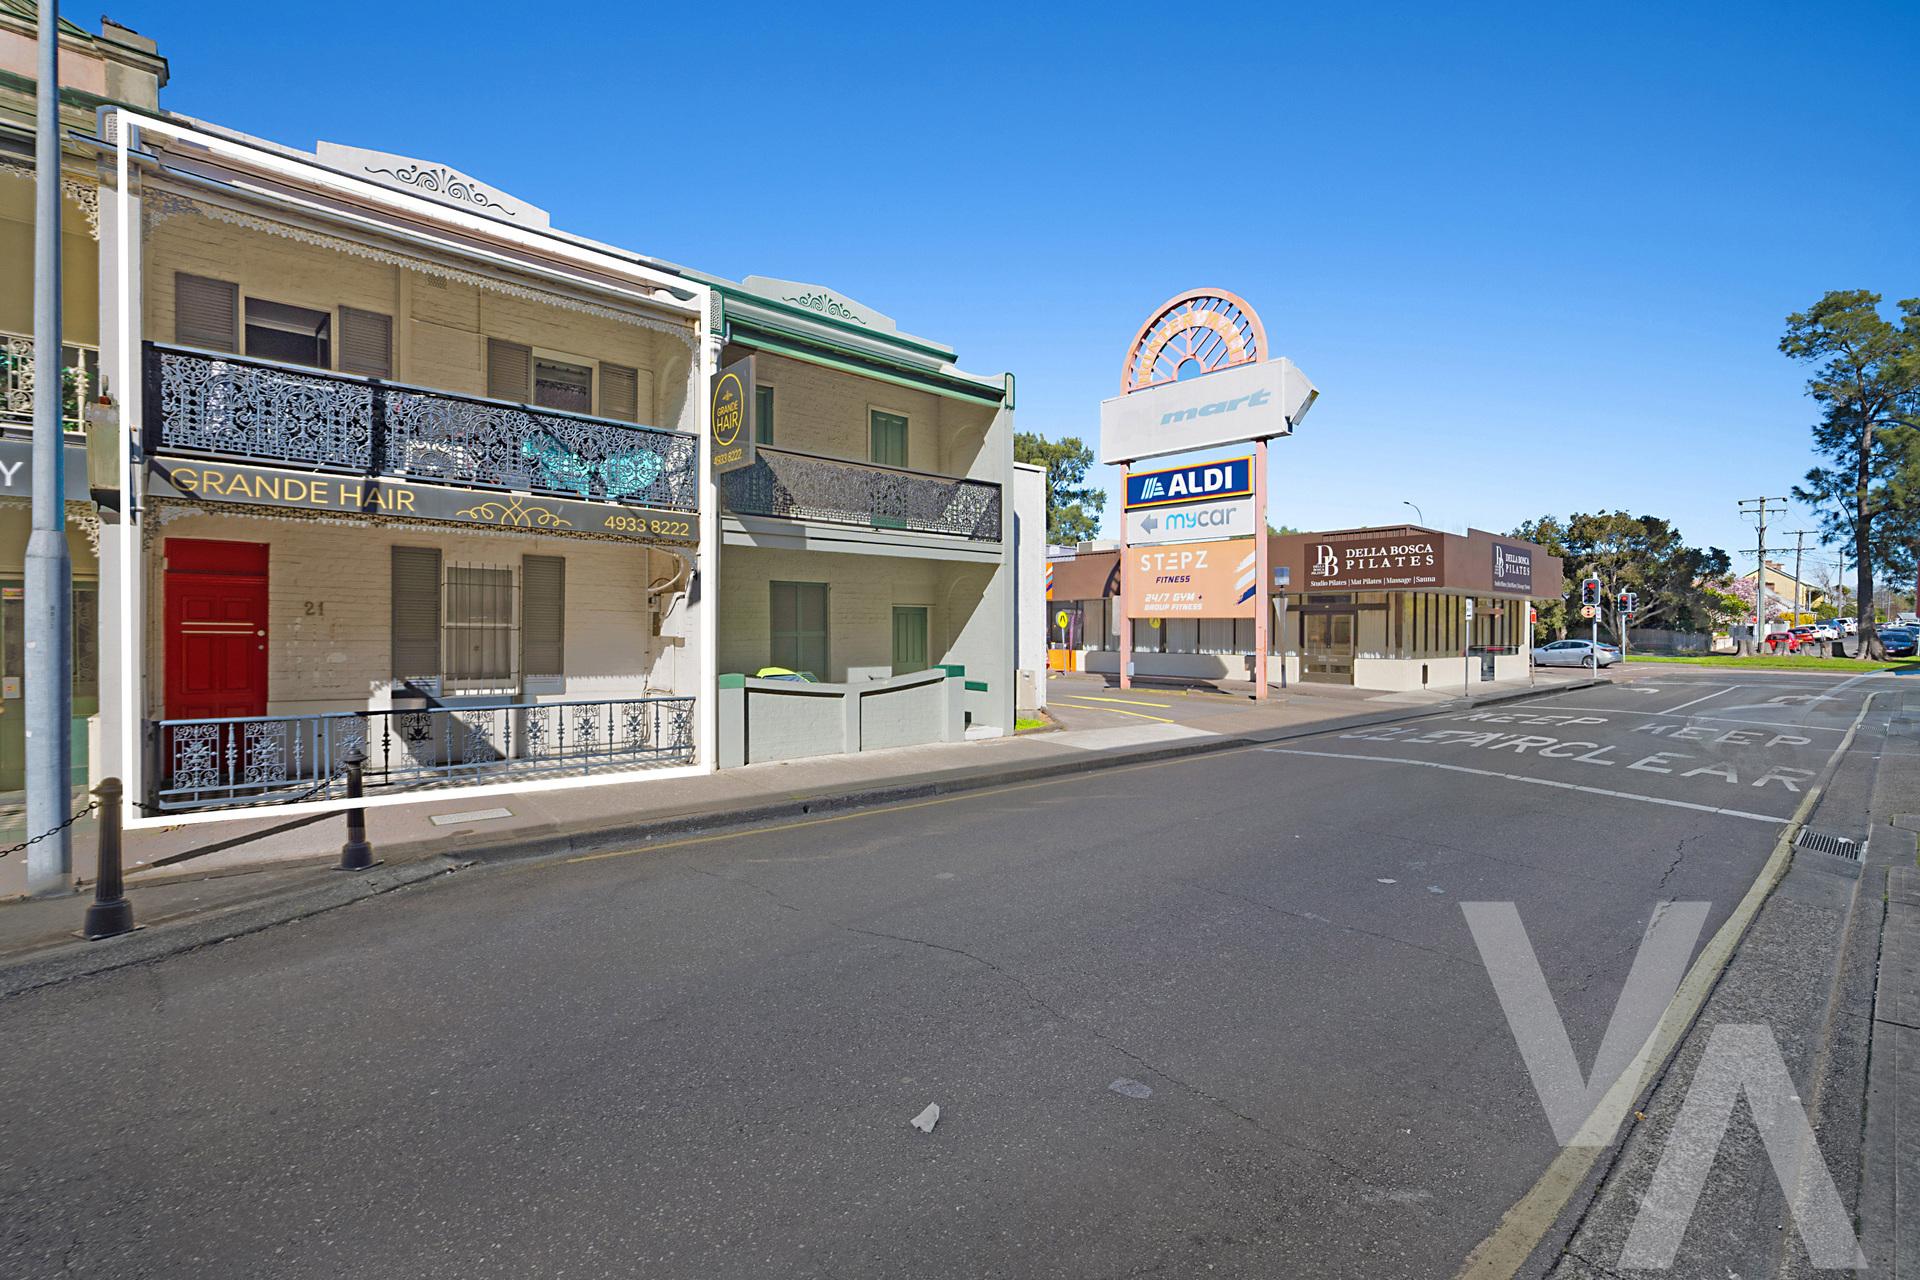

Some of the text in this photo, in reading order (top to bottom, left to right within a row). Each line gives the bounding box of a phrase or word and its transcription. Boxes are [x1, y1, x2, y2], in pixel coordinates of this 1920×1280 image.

[717, 400, 738, 416] GRANDE
[1160, 389, 1271, 426] mart
[716, 411, 738, 433] HAIR
[170, 468, 416, 512] GRANDE HAIR
[1168, 466, 1232, 496] ALDI
[604, 516, 689, 536] 4933 8222
[1166, 507, 1237, 531] mycar
[1346, 544, 1434, 558] DELLA BOSCA
[1140, 551, 1208, 572] STEPZ
[1346, 555, 1434, 570] PILATES
[1505, 564, 1530, 576] PILATES
[1156, 575, 1191, 584] FITNESS
[1144, 592, 1195, 602] 24/7 GYM
[304, 601, 325, 616] 21
[1629, 723, 1812, 748] KEEP
[1538, 742, 1817, 792] CLEAR
